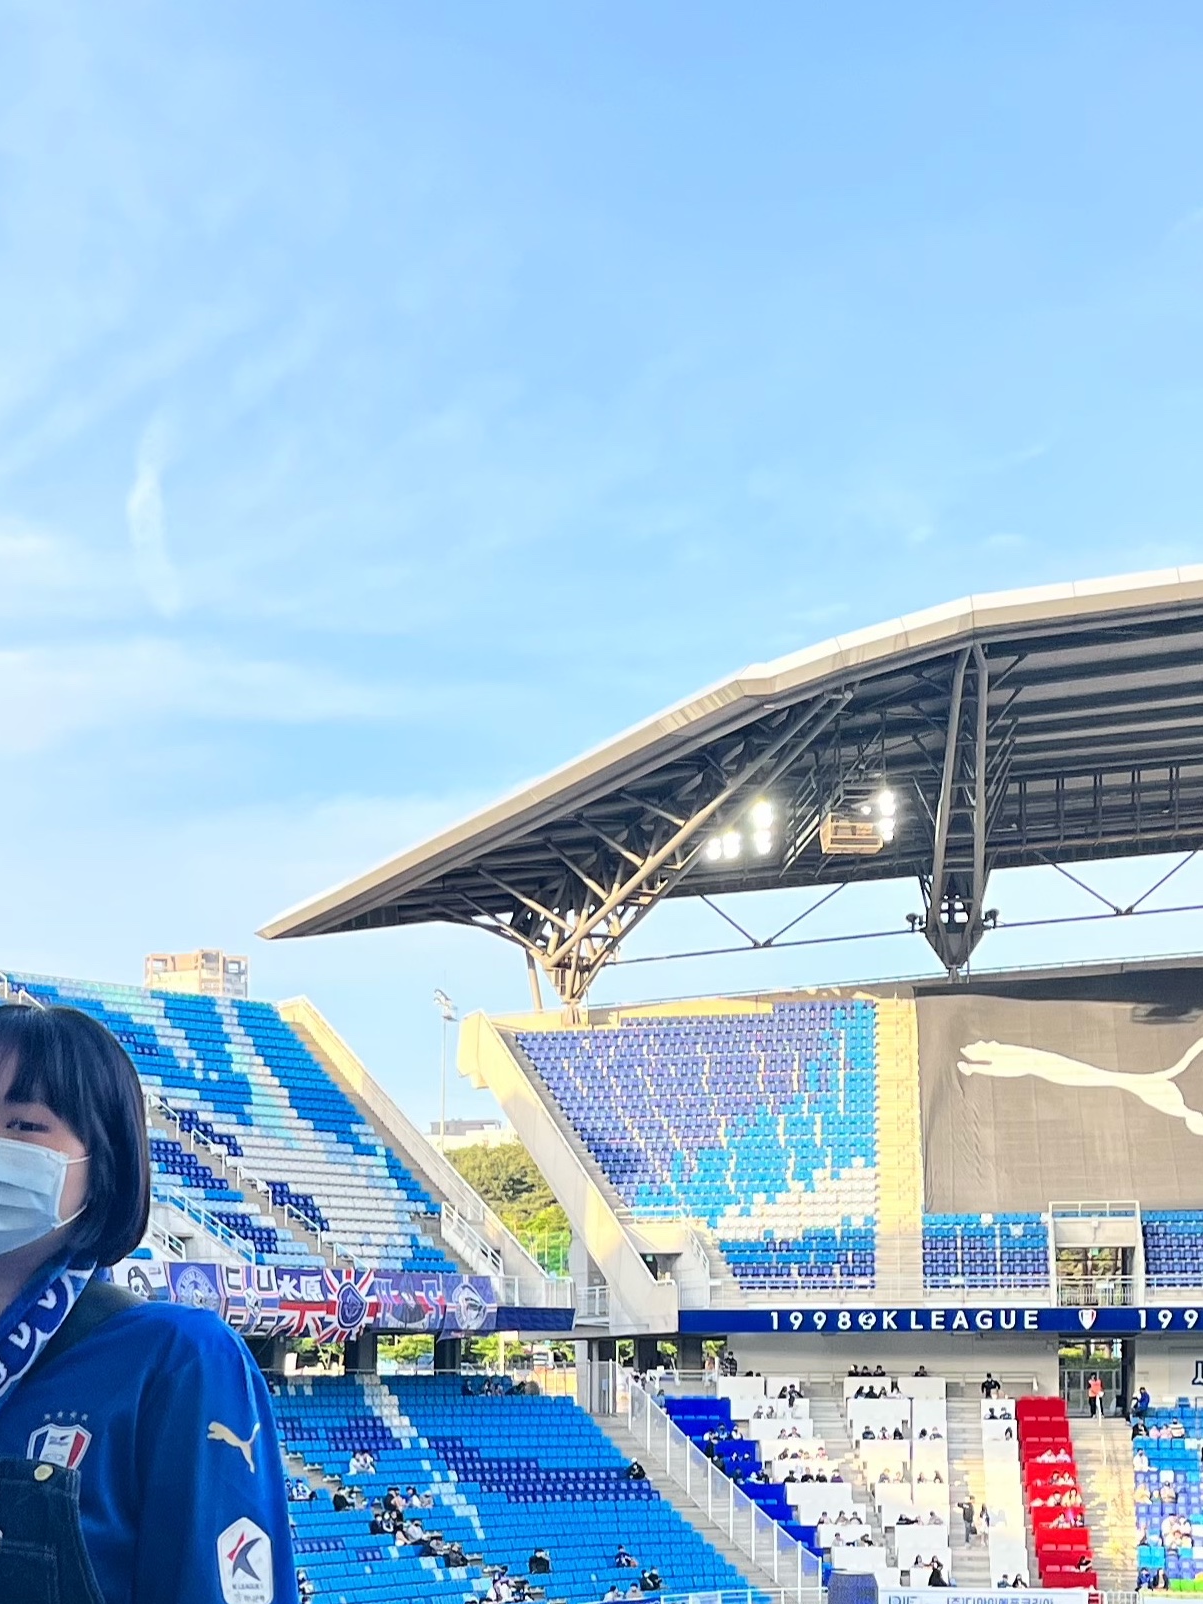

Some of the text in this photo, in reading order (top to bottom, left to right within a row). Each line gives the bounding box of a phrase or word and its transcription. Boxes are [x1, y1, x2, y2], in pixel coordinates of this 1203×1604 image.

[278, 1274, 324, 1301] 水原
[770, 1310, 849, 1331] 1998
[909, 1310, 1039, 1330] LEAGUE
